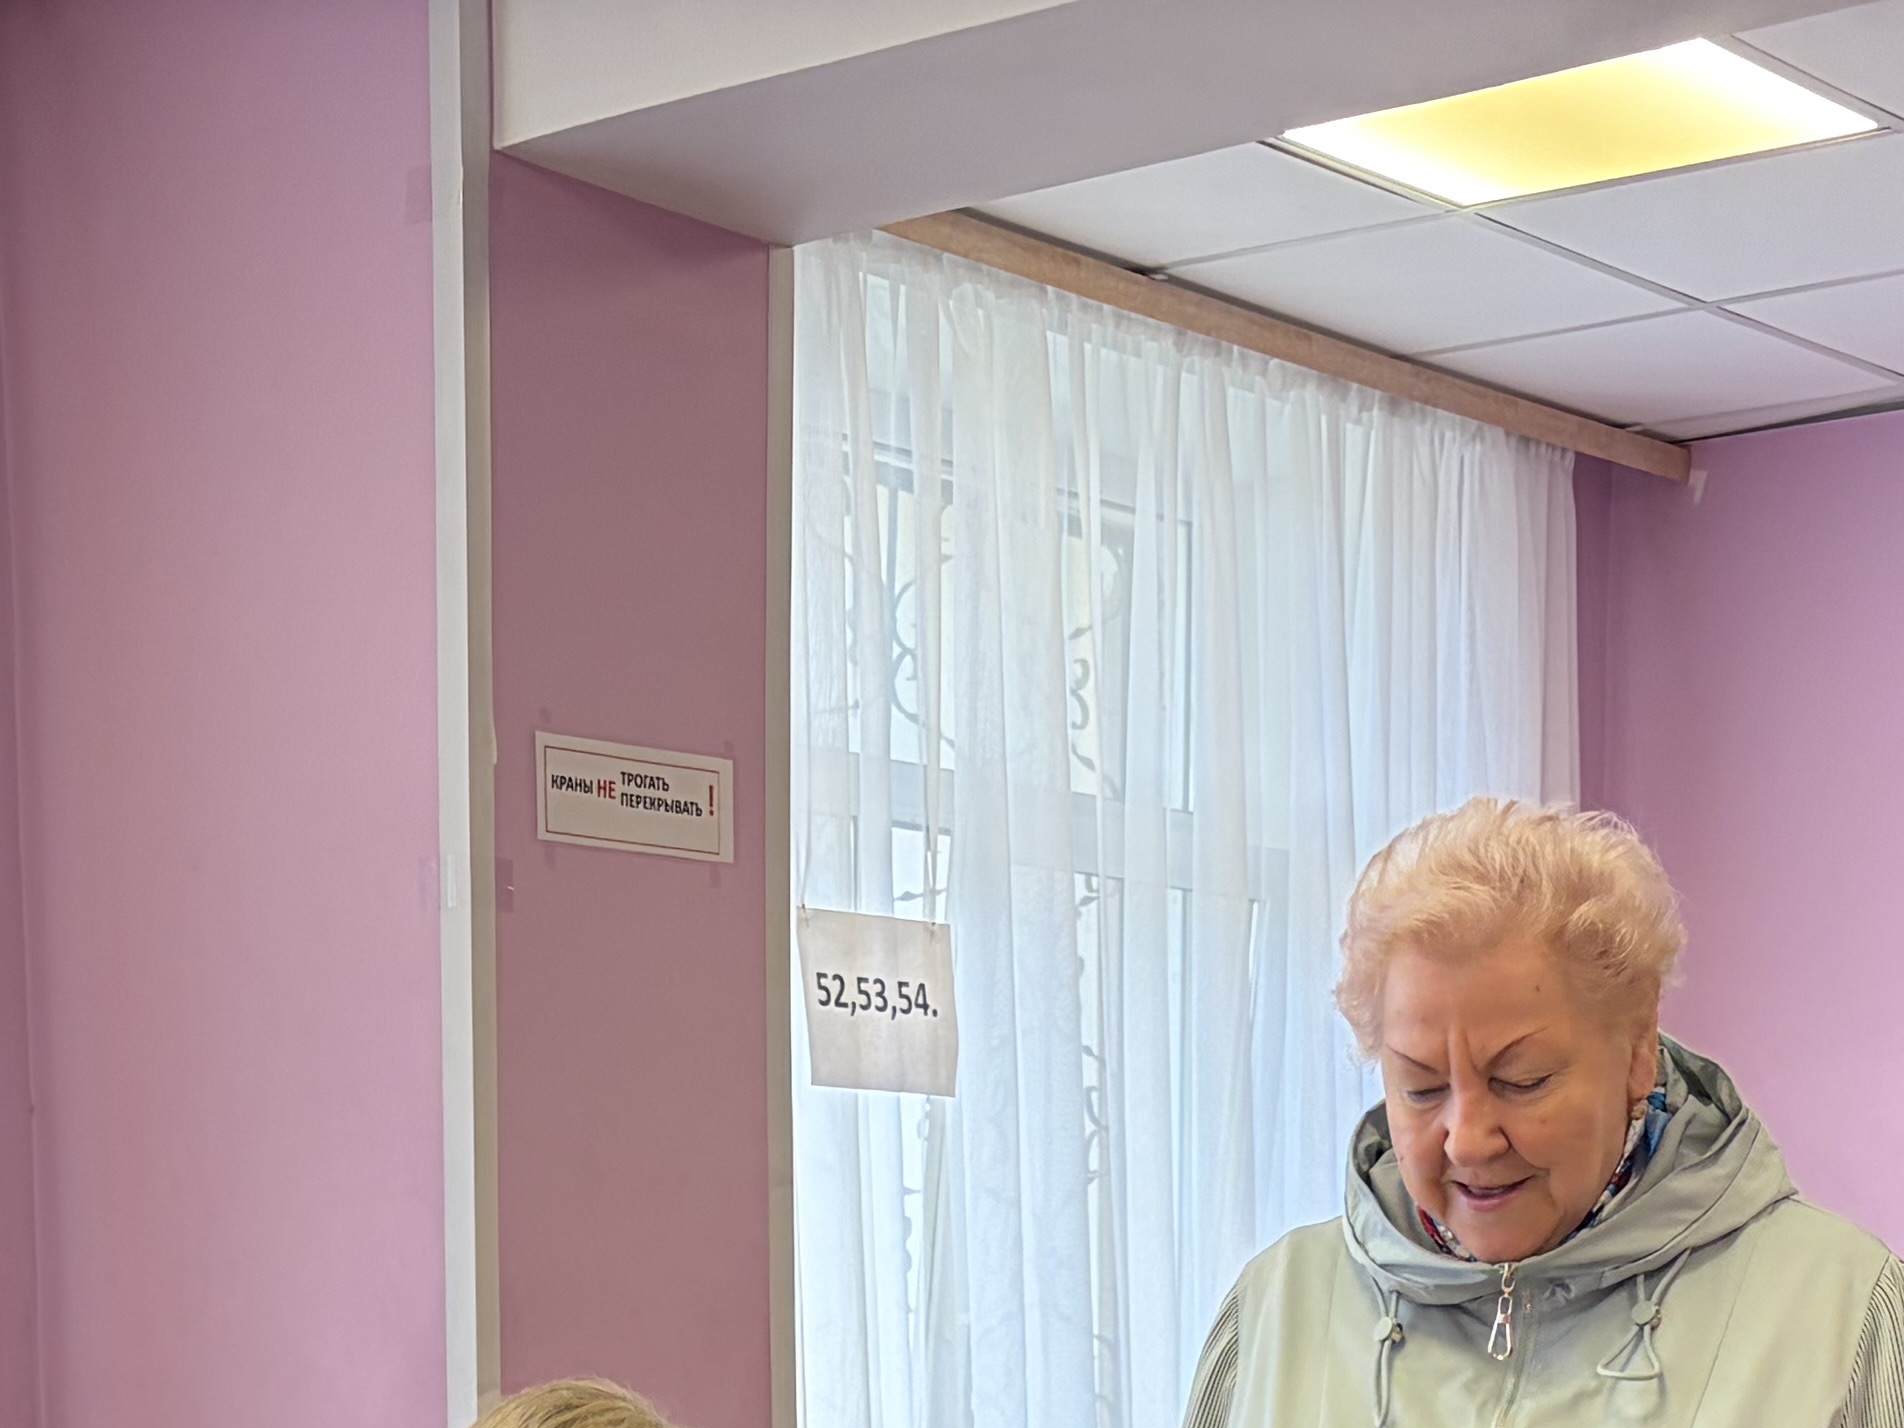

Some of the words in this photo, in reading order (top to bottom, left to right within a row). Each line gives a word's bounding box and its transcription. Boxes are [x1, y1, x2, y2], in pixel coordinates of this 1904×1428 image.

[551, 773, 594, 794] КРАНЫ
[597, 778, 617, 800] НЕ
[620, 771, 670, 793] ТРОГАТЬ
[620, 792, 703, 818] ПЕРЕКРЫВАТЬ
[815, 971, 939, 1021] 52,53,54.
